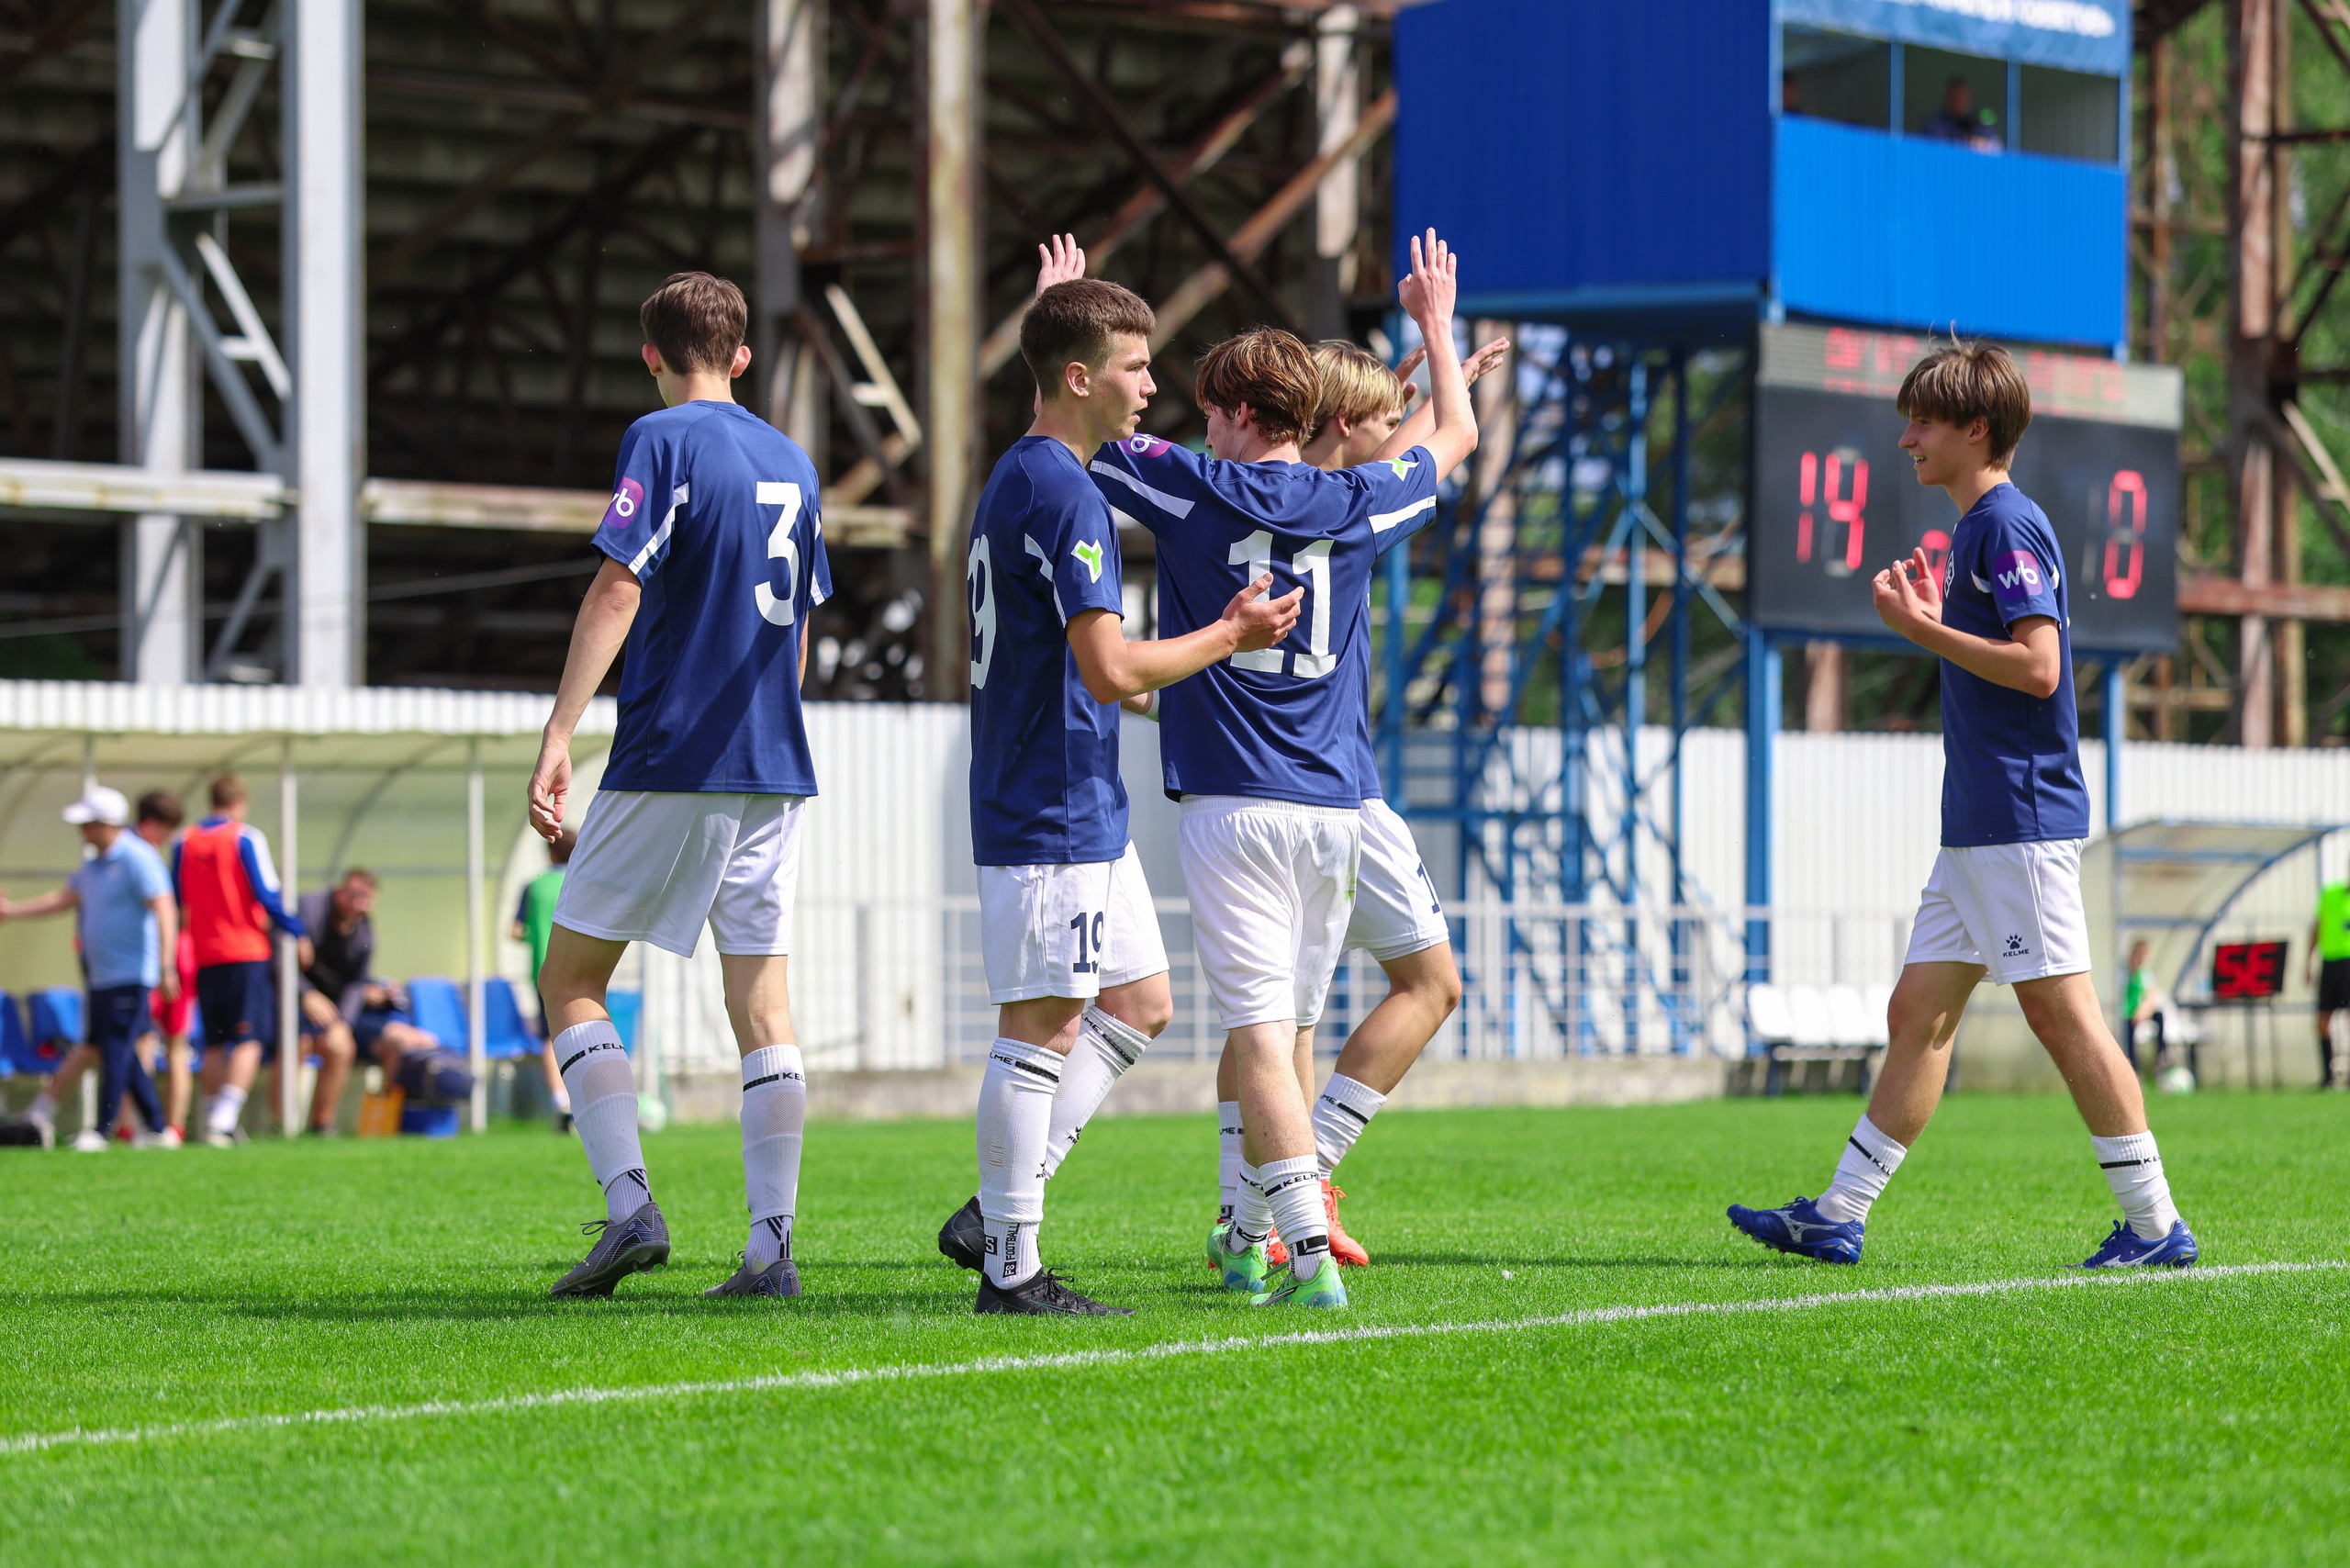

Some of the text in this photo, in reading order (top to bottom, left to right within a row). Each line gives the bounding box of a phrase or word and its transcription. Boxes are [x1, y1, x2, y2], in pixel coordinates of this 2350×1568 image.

[611, 487, 634, 517] b
[755, 482, 801, 626] 3
[1998, 560, 2038, 589] wb
[1228, 530, 1337, 678] 11
[1070, 912, 1103, 974] 19
[2003, 948, 2030, 958] KELME
[1005, 1223, 1020, 1260] FOOTBALL
